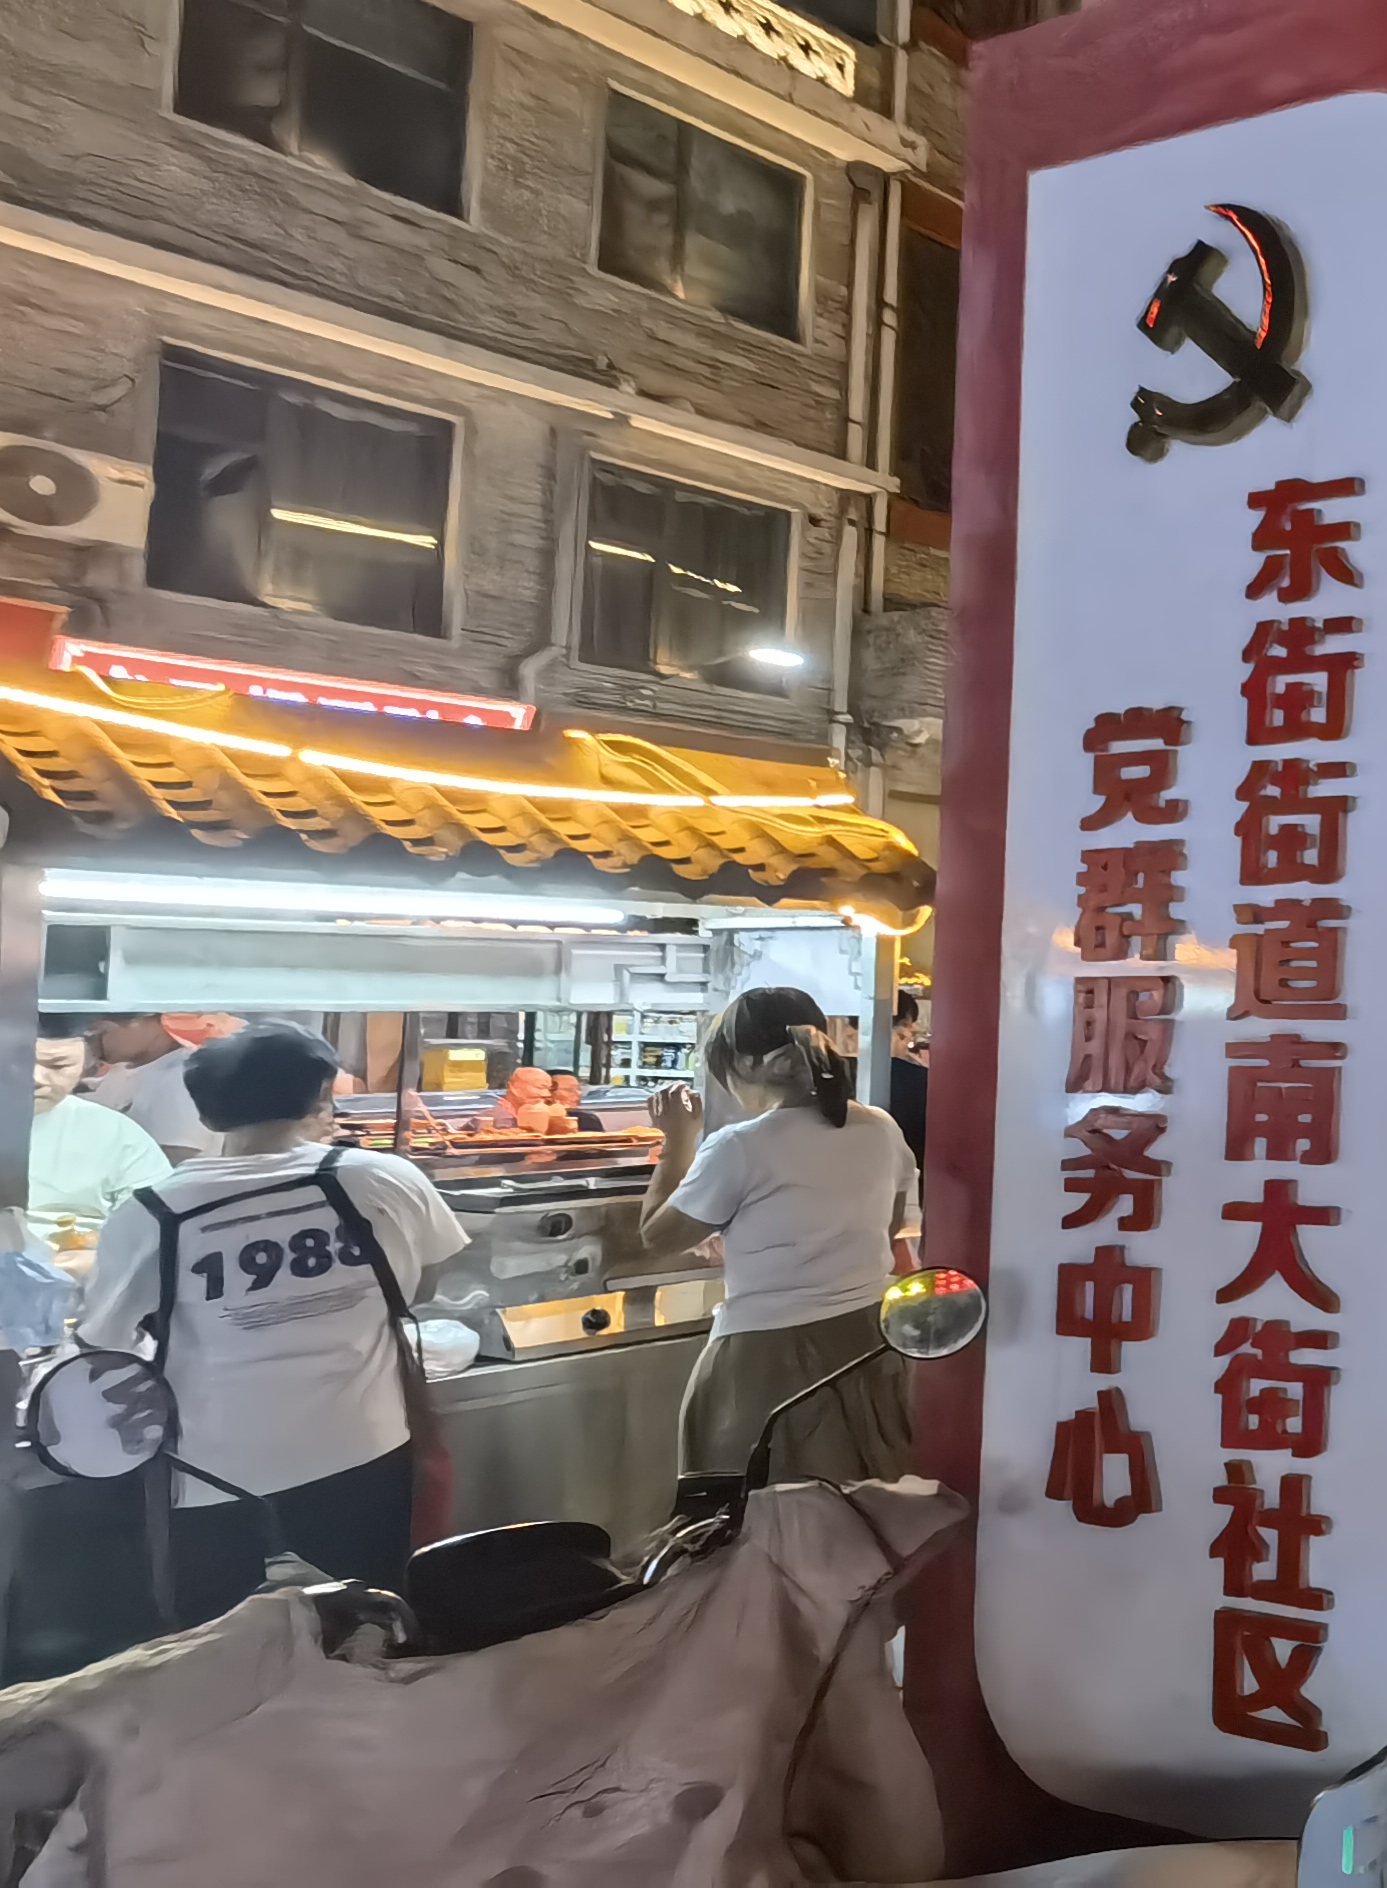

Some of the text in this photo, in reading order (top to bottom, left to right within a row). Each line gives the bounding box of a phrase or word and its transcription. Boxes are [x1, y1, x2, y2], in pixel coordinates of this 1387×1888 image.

[1045, 706, 1193, 1528] 党群服务中心
[1209, 476, 1366, 1752] 东街街道南大街社区
